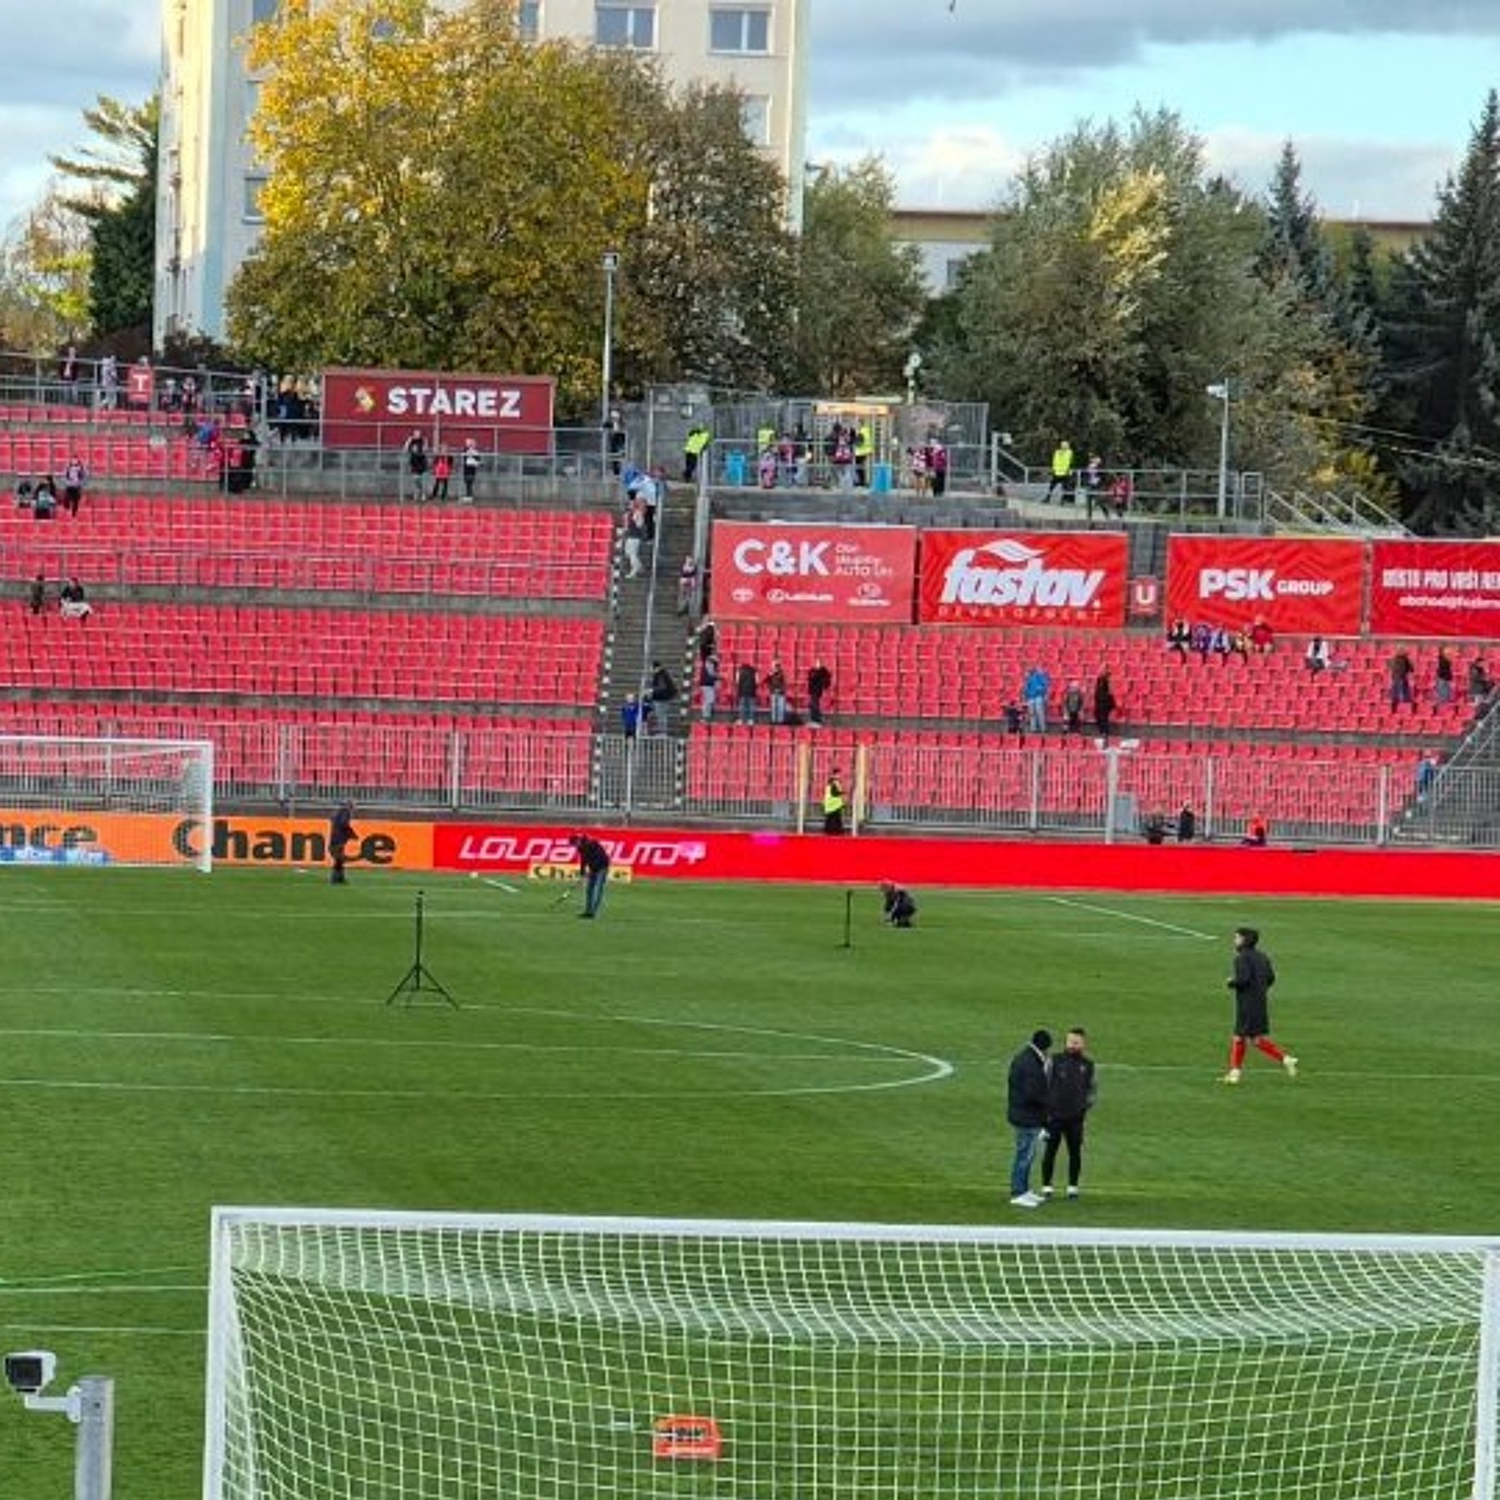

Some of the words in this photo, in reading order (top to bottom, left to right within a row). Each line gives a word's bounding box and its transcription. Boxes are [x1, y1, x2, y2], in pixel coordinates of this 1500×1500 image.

[387, 385, 521, 418] STAREZ
[733, 538, 831, 576] C&K
[1200, 568, 1276, 600] PSK
[1277, 580, 1335, 595] GROUP
[533, 865, 628, 880] Chae
